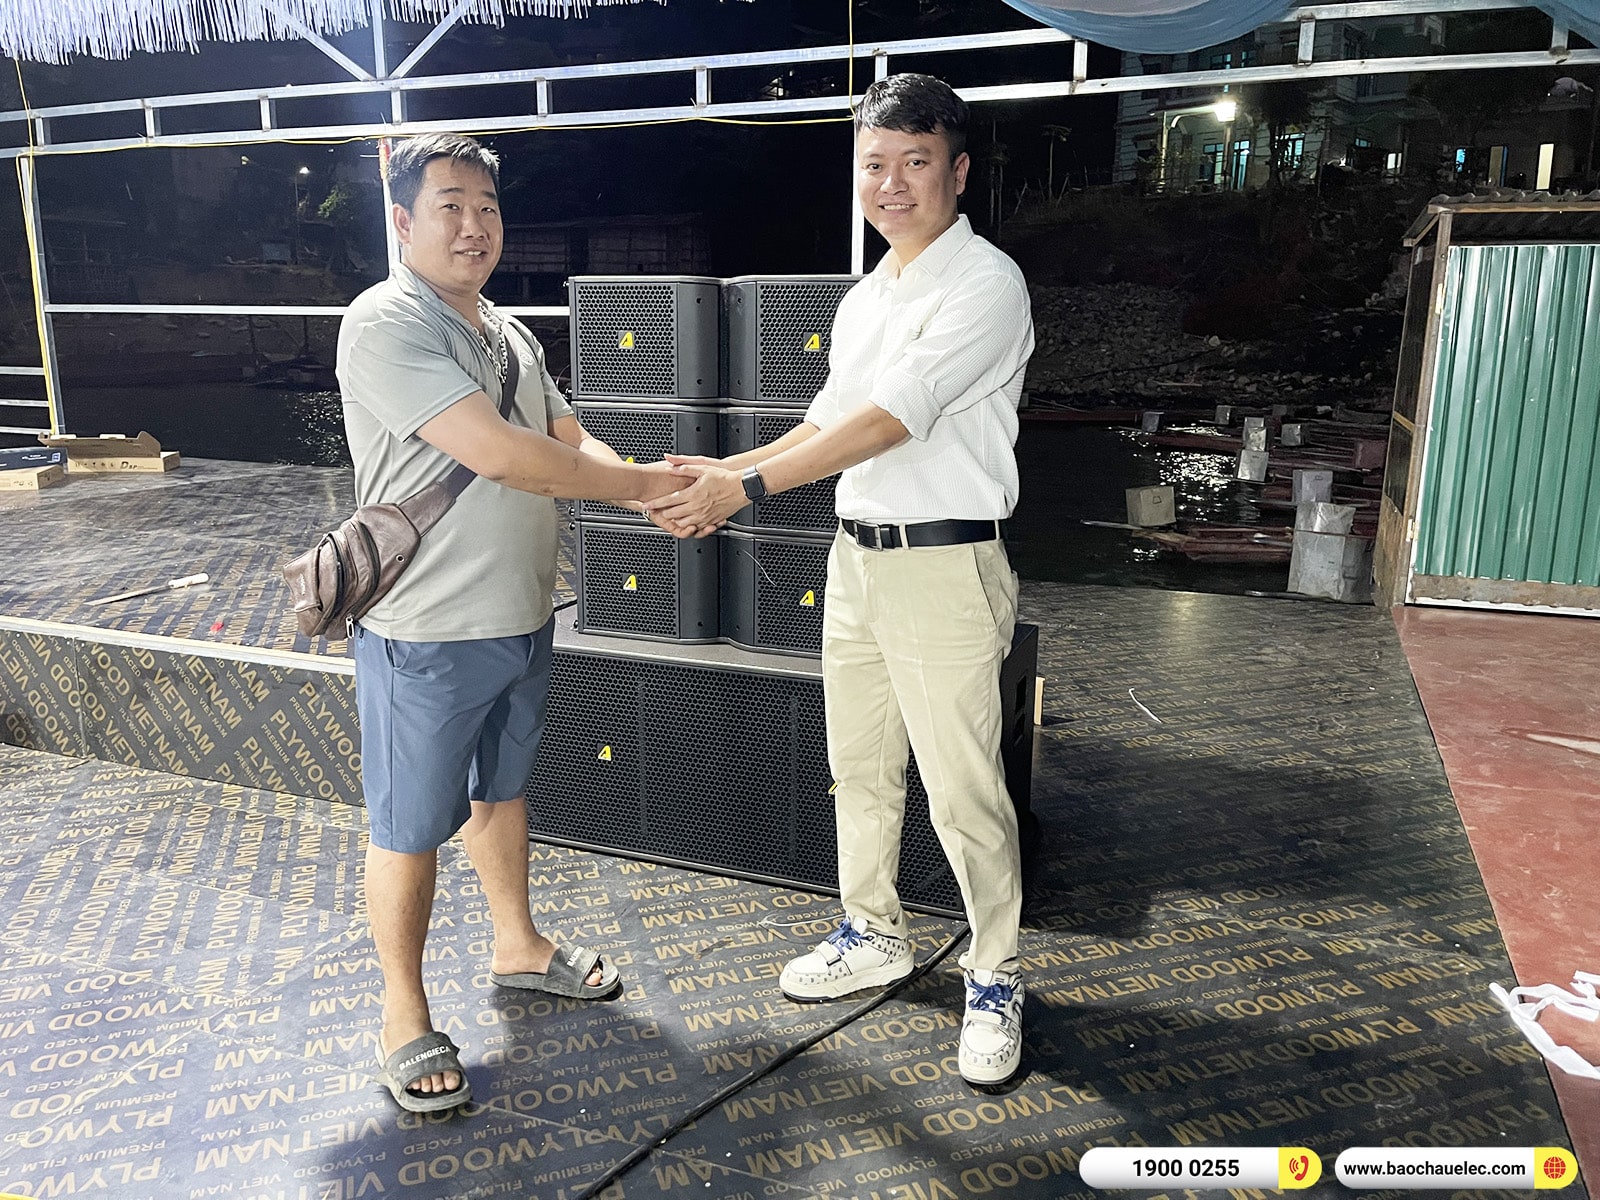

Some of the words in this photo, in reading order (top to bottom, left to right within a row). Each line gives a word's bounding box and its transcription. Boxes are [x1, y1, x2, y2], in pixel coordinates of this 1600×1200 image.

[120, 649, 141, 678] FACED
[143, 681, 173, 721] PLYWOOD
[181, 654, 242, 729] IETNAM
[226, 671, 241, 691] VIET
[239, 691, 255, 711] NAM
[319, 671, 349, 710] PREMIUM
[168, 655, 198, 695] PLYWOOD
[200, 698, 214, 717] VIET
[212, 718, 227, 738] NAM
[153, 667, 215, 755] VIETNAM
[119, 707, 147, 748] PLYWOOD
[129, 694, 189, 775] VIETNAM
[289, 697, 319, 737] PREMIUM
[319, 740, 335, 761] FILM
[335, 763, 357, 793] FACED
[261, 723, 290, 764] PREMIUM
[290, 766, 306, 788] FILM
[542, 860, 596, 872] PREMIUM
[549, 885, 606, 897] PREMIUM
[626, 878, 653, 887] NAM
[637, 905, 666, 914] NAM
[642, 899, 768, 929] VIETNAM
[668, 900, 696, 911] VIET
[1249, 906, 1286, 917] FACED
[130, 892, 180, 961] PLYWOOD
[557, 911, 616, 925] PREMIUM
[650, 933, 680, 943] NAM
[683, 928, 711, 939] VIET
[315, 951, 348, 961] NAM
[734, 948, 797, 964] PLYWOOD
[1158, 953, 1199, 965] FACED
[1203, 947, 1231, 957] FILM
[664, 965, 695, 976] NAM
[698, 960, 728, 971] VIET
[1090, 961, 1152, 978] PLYWOOD
[1171, 946, 1313, 983] PLYWOOD
[1371, 956, 1488, 990] VIETNAM
[1026, 978, 1056, 990] NAM
[1059, 973, 1087, 984] VIET
[1201, 986, 1244, 1000] FACED
[1280, 968, 1337, 985] PREMIUM
[311, 985, 344, 997] NAM
[716, 994, 746, 1005] VIET
[1037, 973, 1174, 1008] VIETNAM
[1214, 977, 1365, 1020] PLYWOOD
[61, 998, 113, 1010] FACED
[120, 991, 158, 1002] FILM
[680, 1000, 711, 1011] NAM
[1130, 995, 1195, 1013] PLYWOOD
[1333, 1004, 1390, 1022] PREMIUM
[306, 1023, 342, 1035] NAM
[484, 1030, 535, 1045] FACED
[544, 1023, 577, 1034] FILM
[585, 1009, 655, 1027] PREMIUM
[1296, 1016, 1329, 1029] FILM
[44, 1035, 100, 1049] FACED
[108, 1028, 147, 1040] FILM
[481, 1021, 662, 1068] PLYWOOD
[696, 1039, 730, 1050] NAM
[734, 1032, 767, 1044] VIET
[1264, 1016, 1422, 1061] PLYWOOD
[882, 1046, 932, 1062] FACED
[490, 1073, 544, 1090] FACED
[552, 1065, 589, 1078] FILM
[597, 1050, 669, 1068] PREMIUM
[797, 1057, 872, 1080] PLYWOOD
[25, 1078, 85, 1093] FACED
[210, 1079, 248, 1093] NAM
[254, 1071, 292, 1085] VIET
[489, 1062, 679, 1112] PLYWOOD
[95, 1090, 177, 1111] PREMIUM
[611, 1094, 687, 1116] PREMIUM
[723, 1073, 888, 1122] VIETNAM
[915, 1090, 966, 1108] FACED
[299, 1100, 385, 1124] PLYWOOD
[824, 1104, 904, 1128] PLYWOOD
[922, 1080, 1105, 1137] PLYWOOD
[200, 1128, 241, 1142] NAM
[247, 1119, 287, 1134] VIET
[781, 1123, 817, 1139] VIET
[1053, 1114, 1127, 1138] PREMIUM
[194, 1117, 384, 1174] VIETNAM
[403, 1135, 463, 1156] FACED
[473, 1124, 513, 1140] FILM
[737, 1131, 776, 1147] NAM
[1010, 1132, 1049, 1147] FILM
[77, 1140, 166, 1163] PREMIUM
[744, 1121, 921, 1177] VIETNAM
[950, 1142, 1004, 1162] FACED
[21, 1157, 67, 1173] FILM
[294, 1152, 386, 1179] PLYWOOD
[534, 1158, 616, 1184] PREMIUM
[855, 1157, 939, 1184] PLYWOOD
[239, 1173, 282, 1190] VIET
[190, 1183, 233, 1199] NAM
